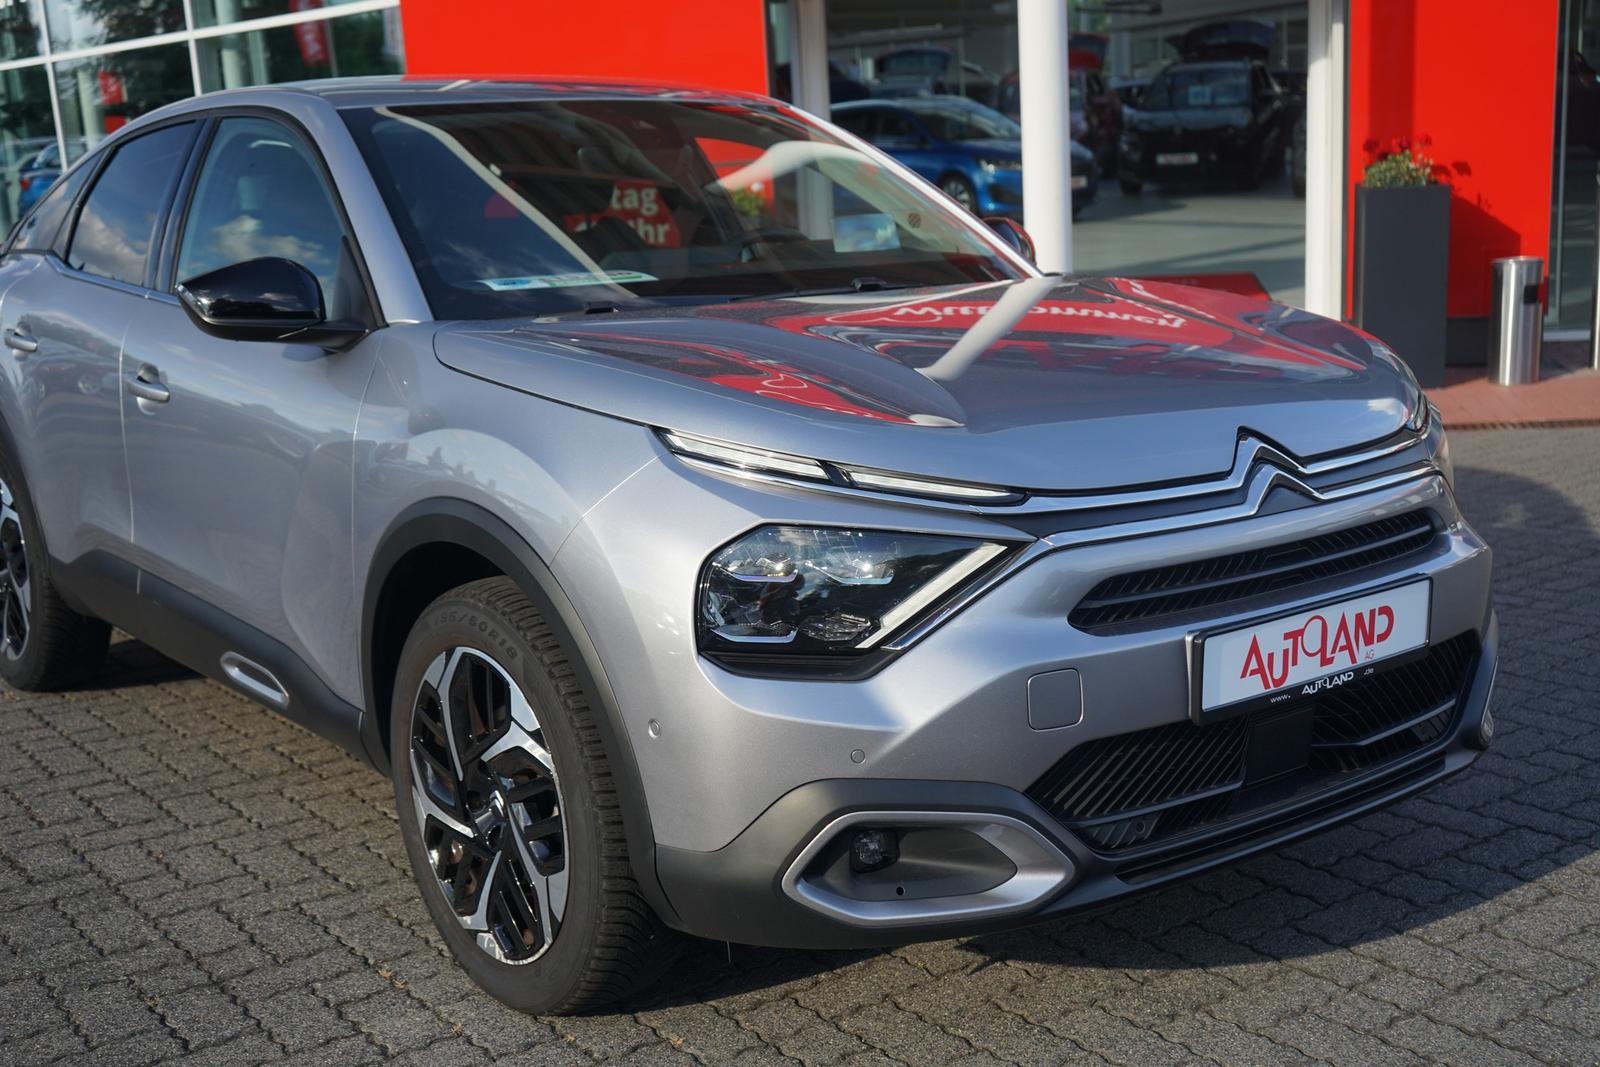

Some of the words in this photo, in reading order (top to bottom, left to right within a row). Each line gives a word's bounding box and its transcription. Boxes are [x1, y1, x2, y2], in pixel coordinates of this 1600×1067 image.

[1240, 605, 1395, 690] AUTOLAND
[1270, 694, 1292, 704] www.
[1301, 671, 1355, 695] AUTOLAND
